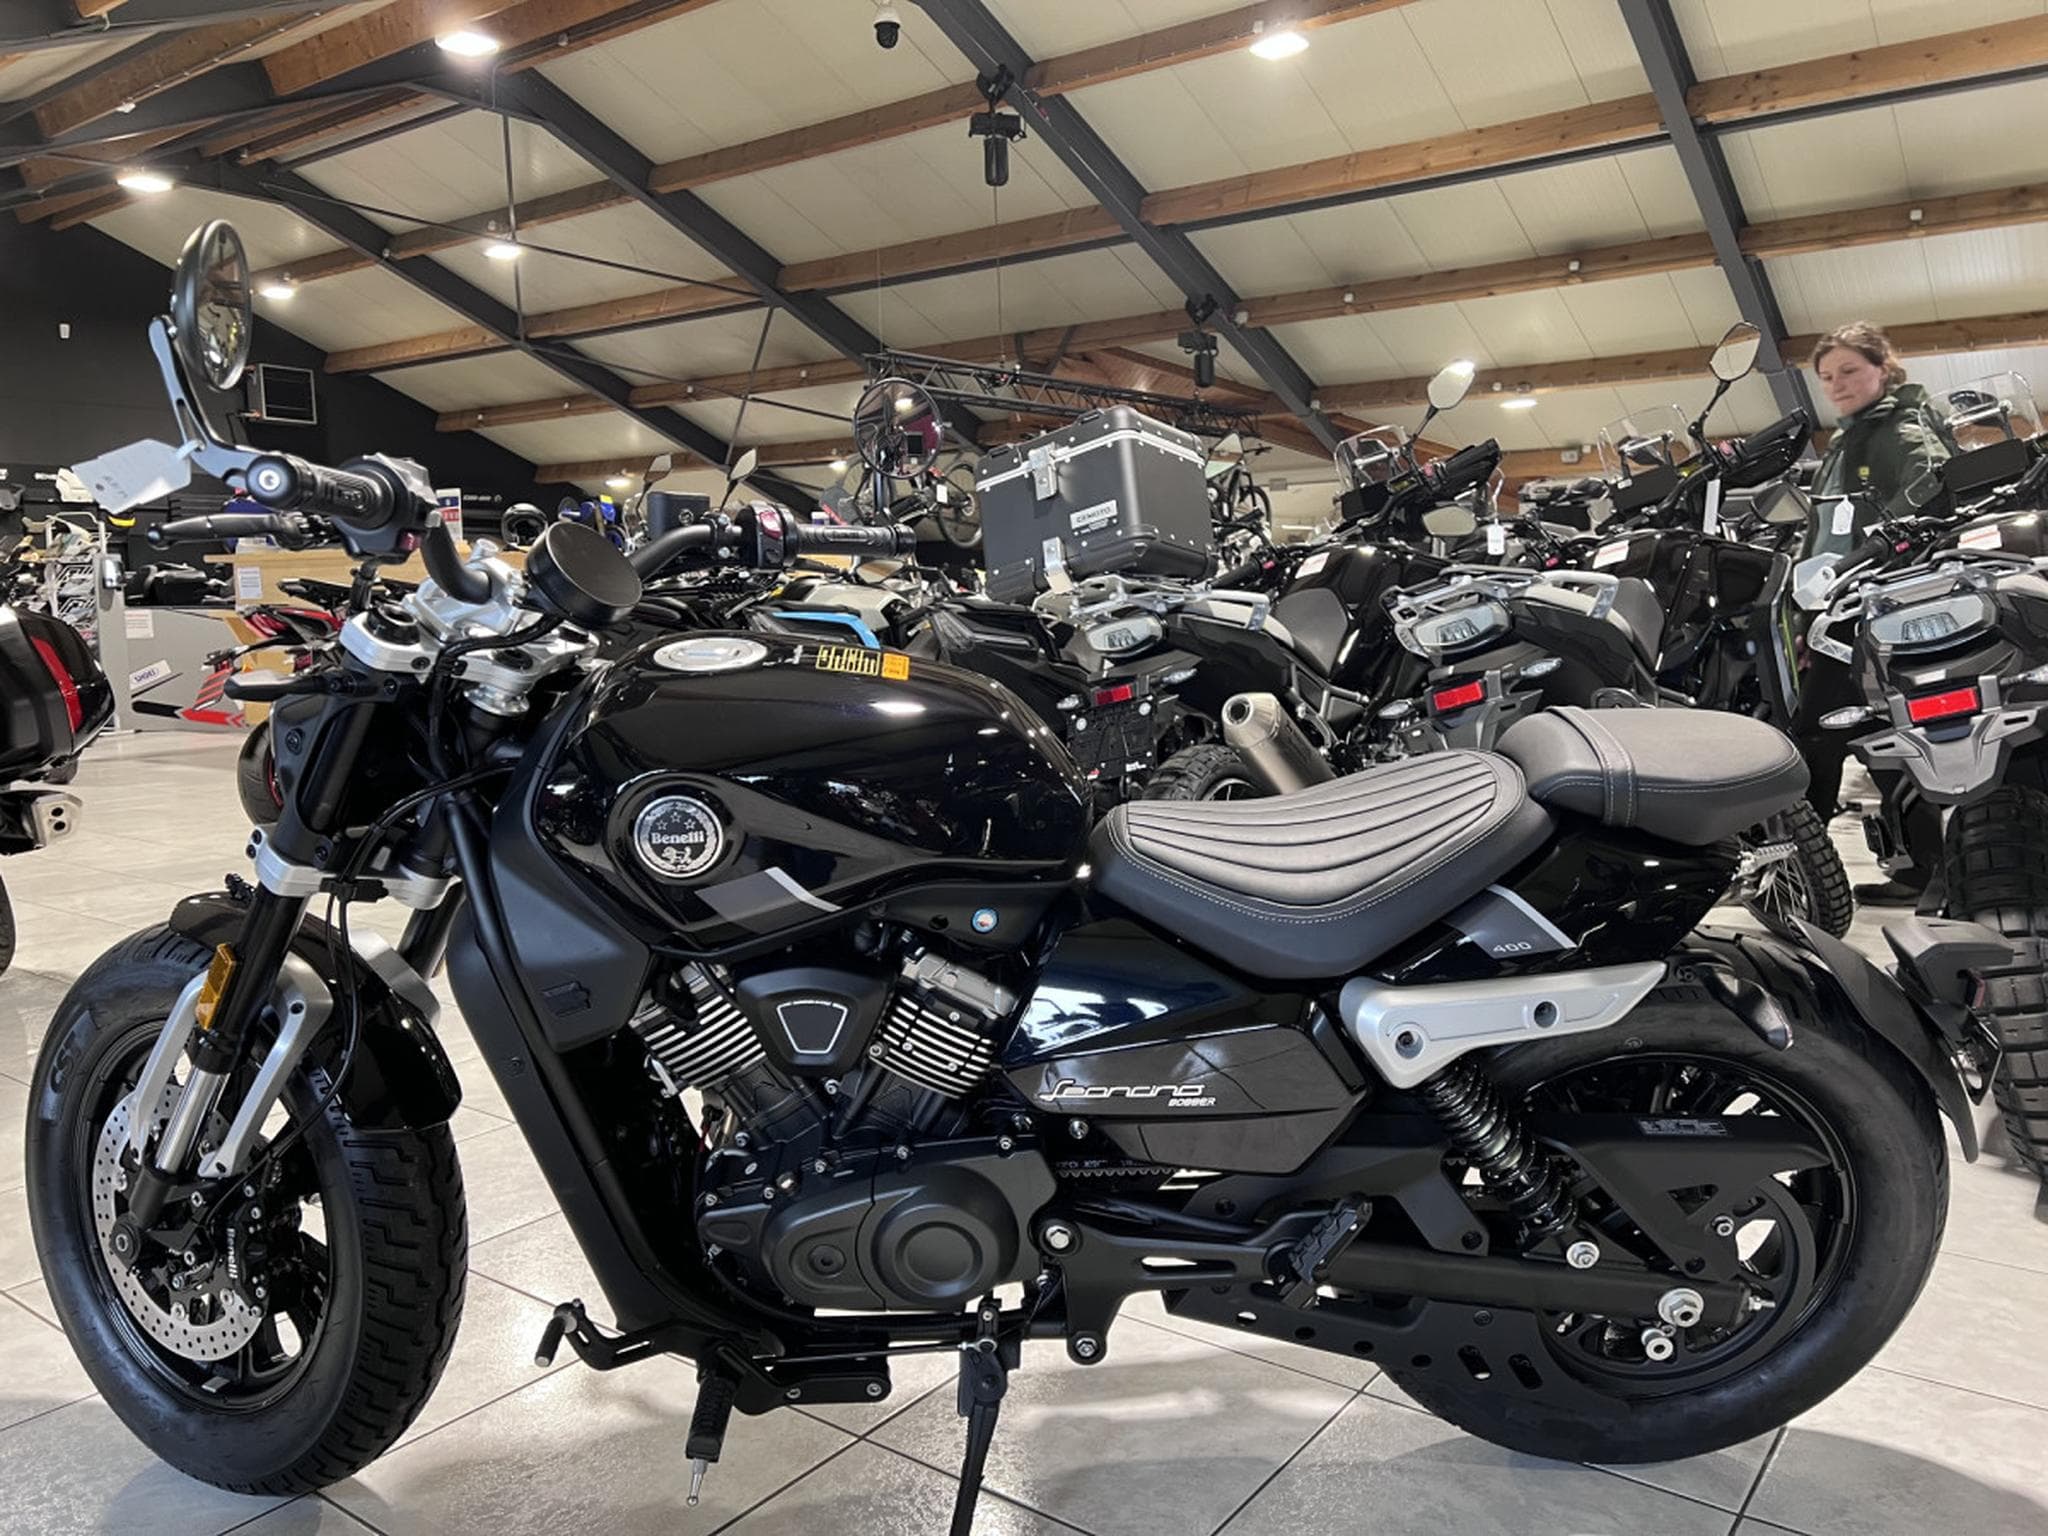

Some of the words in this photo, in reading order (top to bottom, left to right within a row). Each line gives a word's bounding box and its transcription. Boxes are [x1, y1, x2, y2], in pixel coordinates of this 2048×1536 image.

[651, 831, 704, 844] Benelli
[1493, 941, 1532, 953] 400
[1168, 1097, 1217, 1107] BOBBER
[226, 1227, 239, 1279] Benelli
